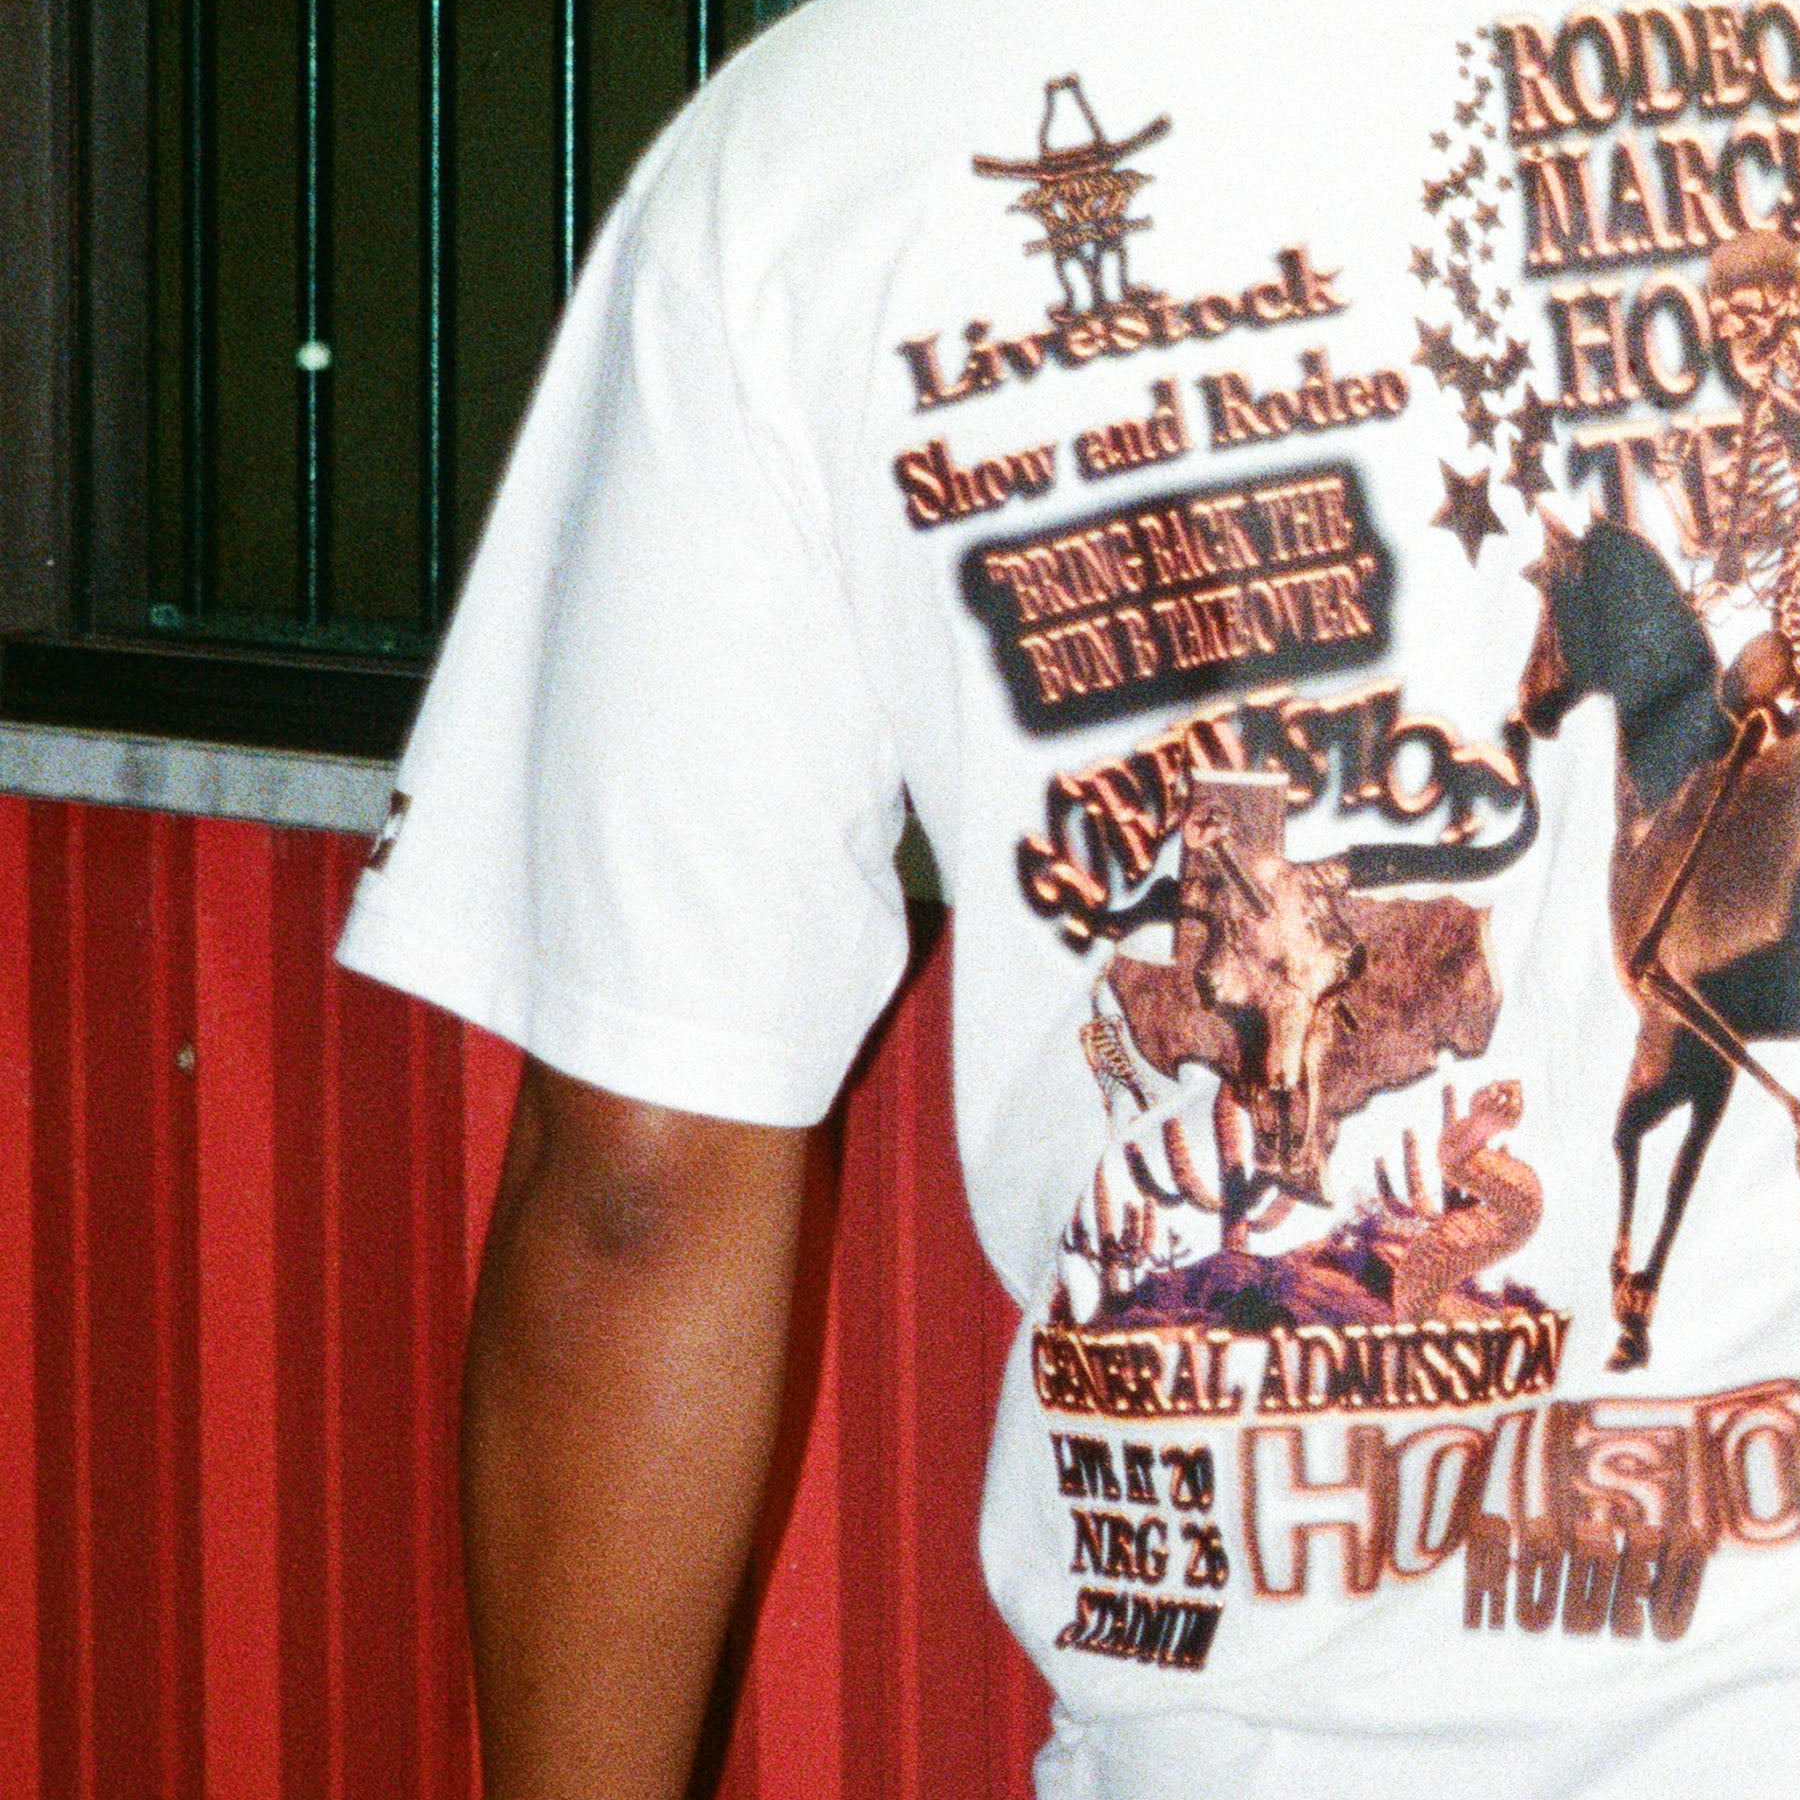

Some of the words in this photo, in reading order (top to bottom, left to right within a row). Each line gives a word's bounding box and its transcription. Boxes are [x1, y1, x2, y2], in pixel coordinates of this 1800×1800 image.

[896, 243, 1357, 413] Livestock
[893, 435, 1058, 532] Show
[1073, 374, 1192, 484] and
[1196, 343, 1413, 451] Rodeo
[1137, 493, 1261, 588] BACK
[1253, 476, 1354, 562] THE
[1017, 616, 1126, 704] BUN
[1256, 1313, 1573, 1412] ADMISSION
[1068, 1504, 1170, 1586] NRG
